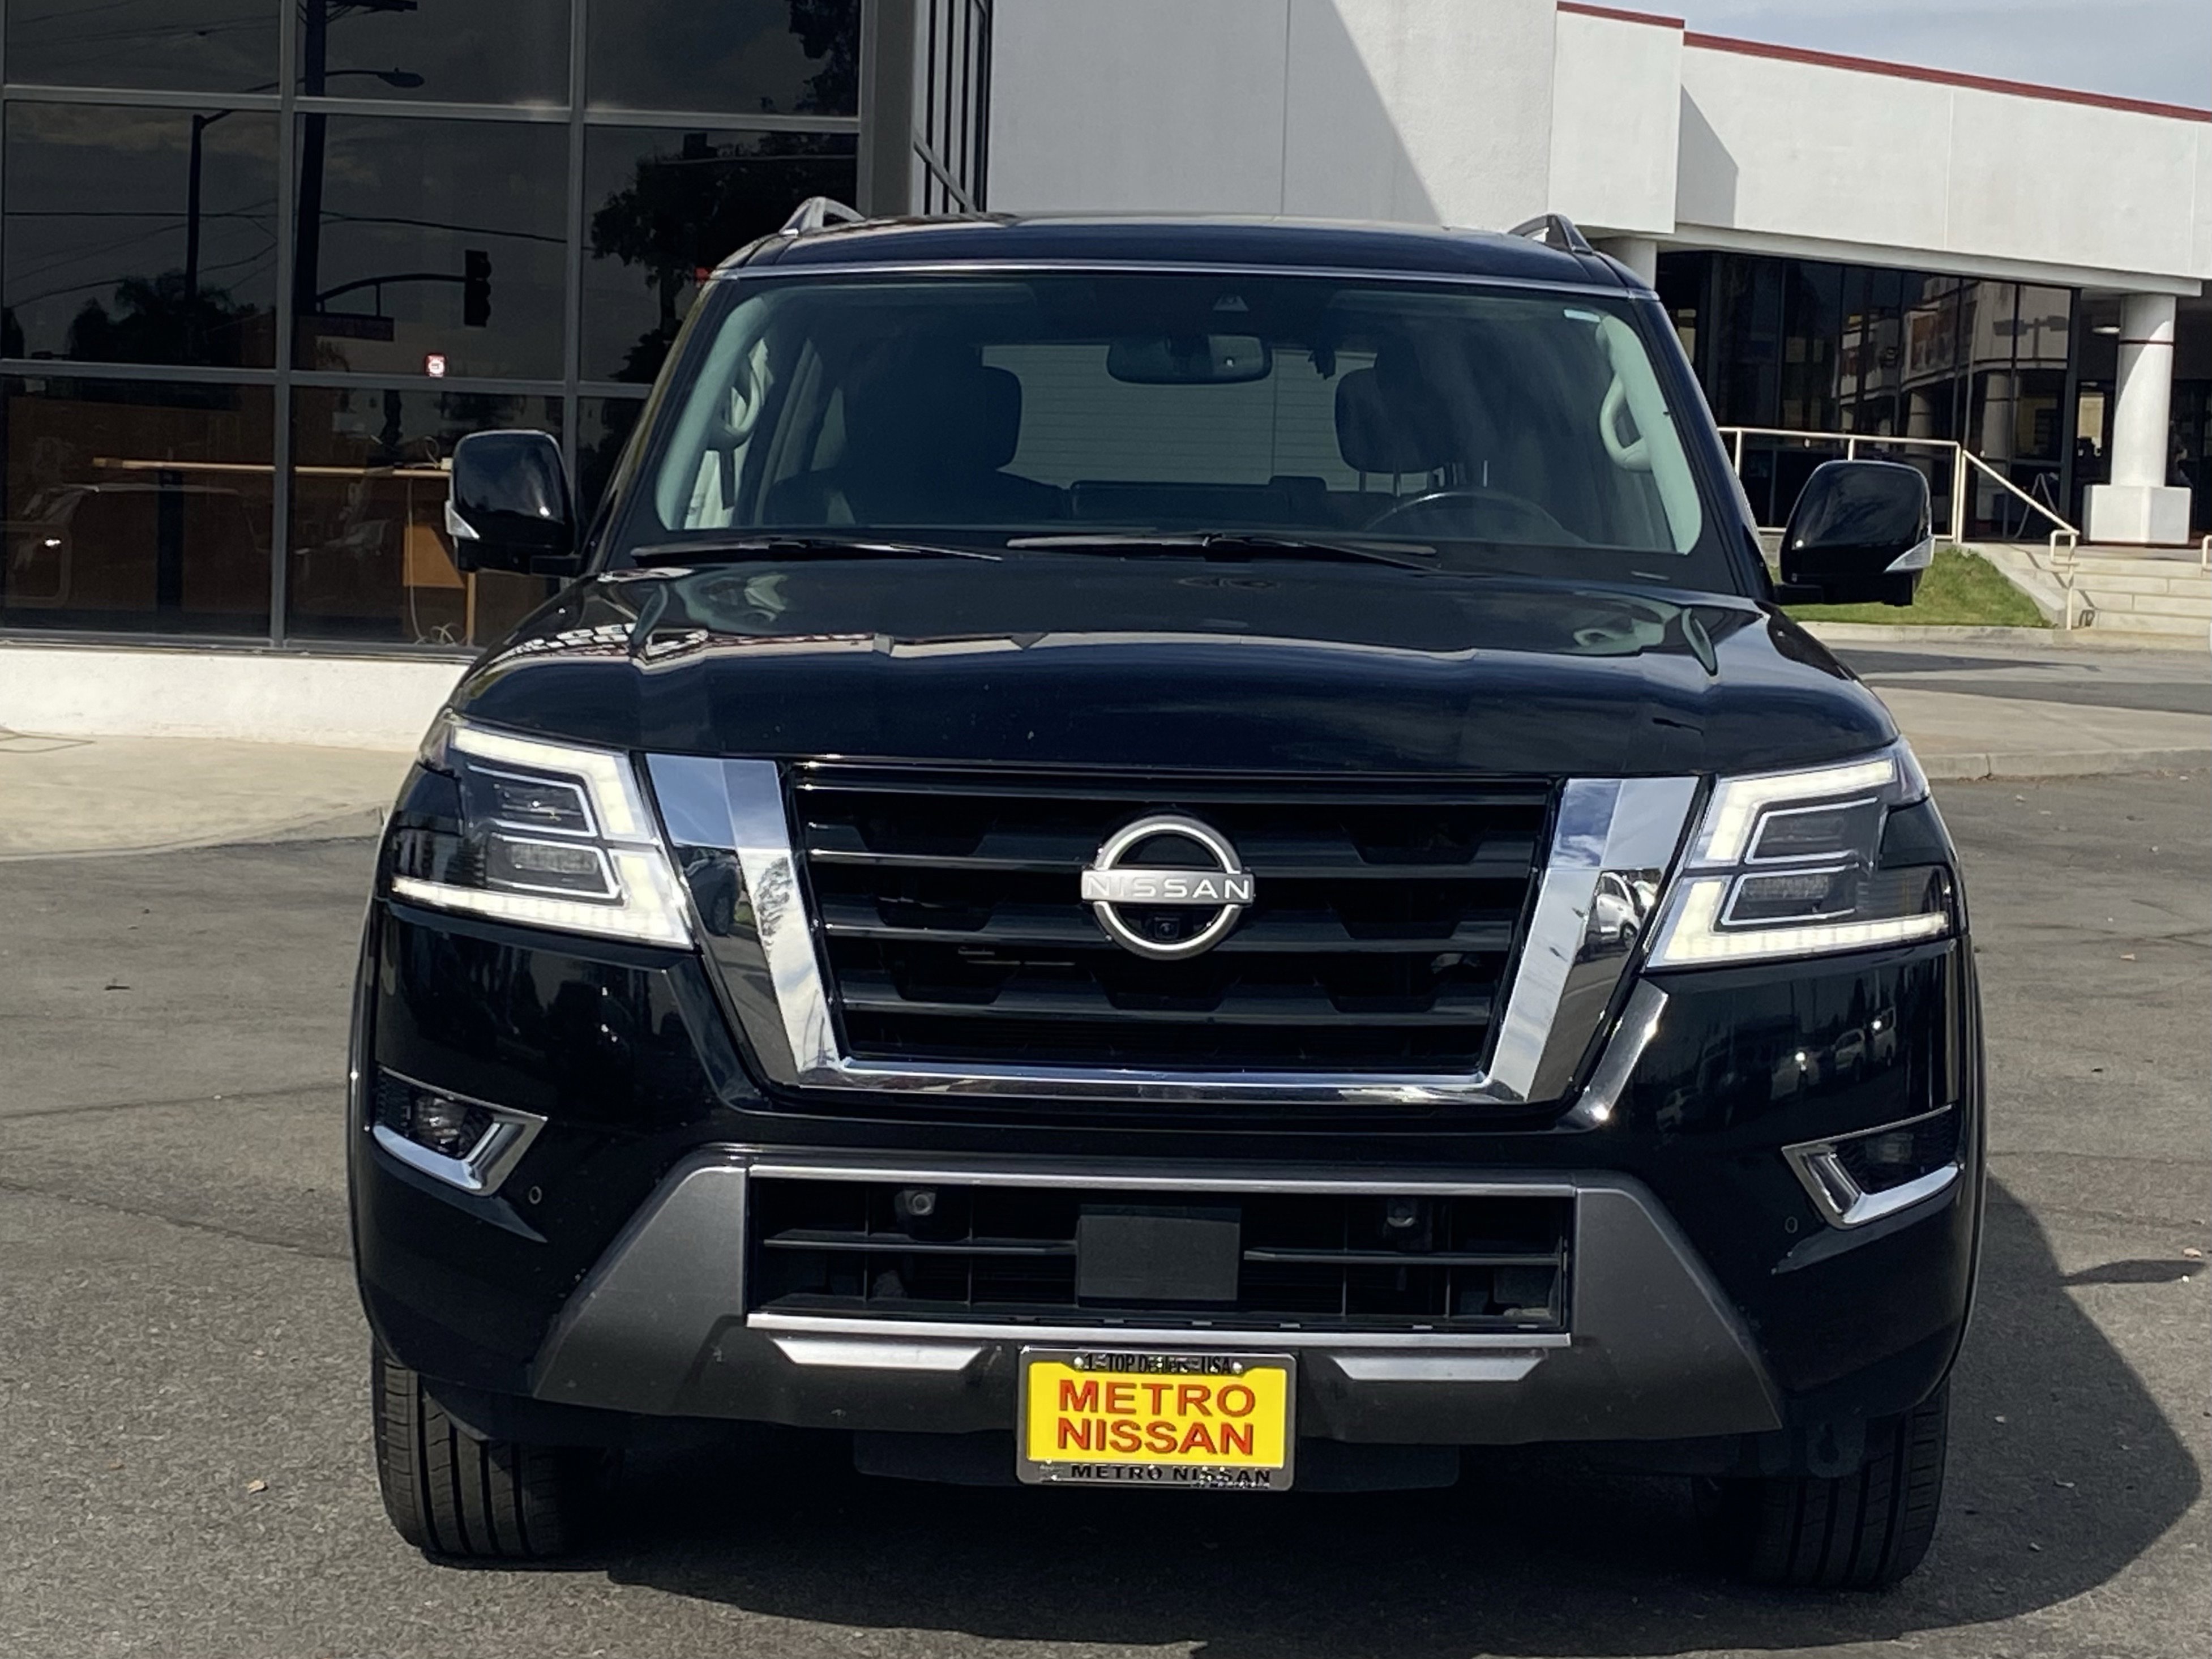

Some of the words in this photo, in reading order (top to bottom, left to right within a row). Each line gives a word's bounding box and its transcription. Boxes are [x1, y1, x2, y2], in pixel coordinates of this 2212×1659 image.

[1086, 875, 1250, 900] NISSAN
[1058, 1379, 1256, 1417] METRO
[1057, 1417, 1254, 1456] NISSAN
[1071, 1464, 1163, 1480] METRO
[1173, 1465, 1272, 1483] NISSAN
